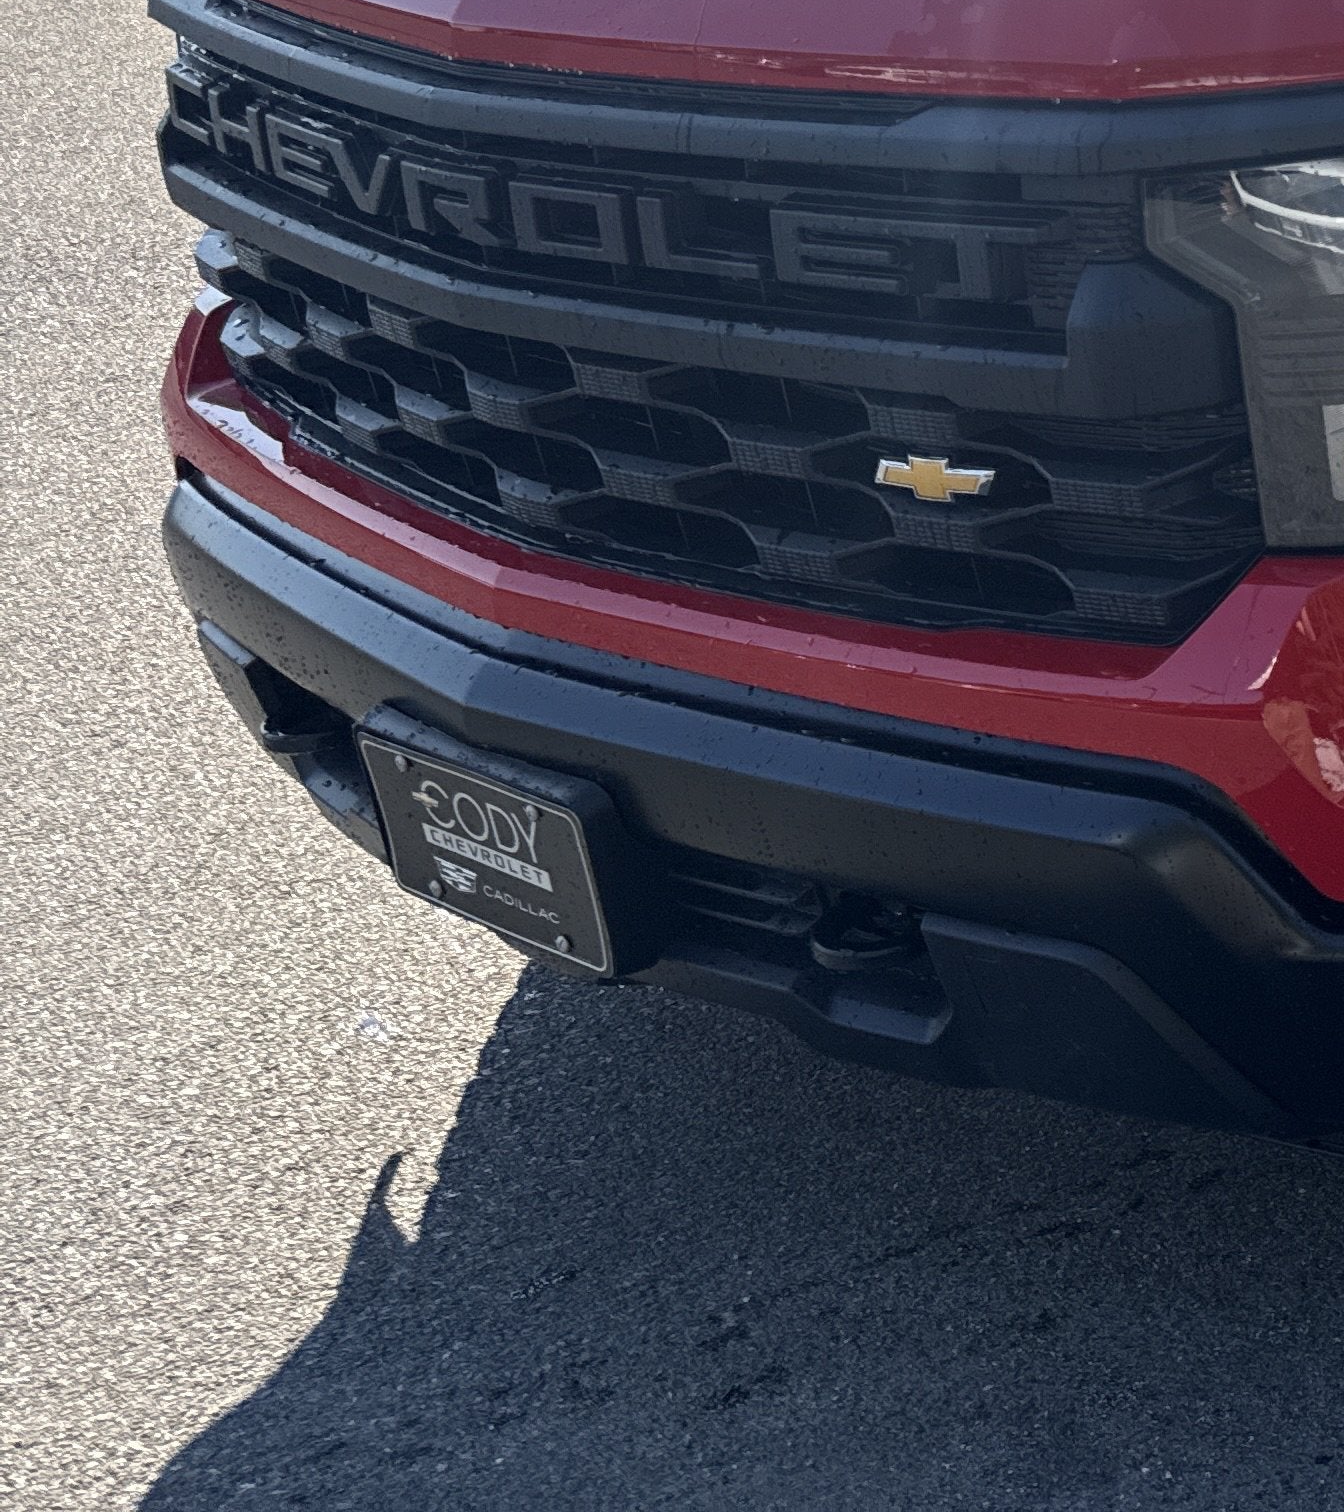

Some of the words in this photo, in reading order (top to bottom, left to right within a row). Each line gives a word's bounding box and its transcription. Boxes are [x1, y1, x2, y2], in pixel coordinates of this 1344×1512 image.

[165, 59, 1076, 302] CHEVROLET
[416, 779, 539, 864] CODY
[430, 827, 545, 886] CHEVROLET
[482, 884, 561, 925] CADILLAC
